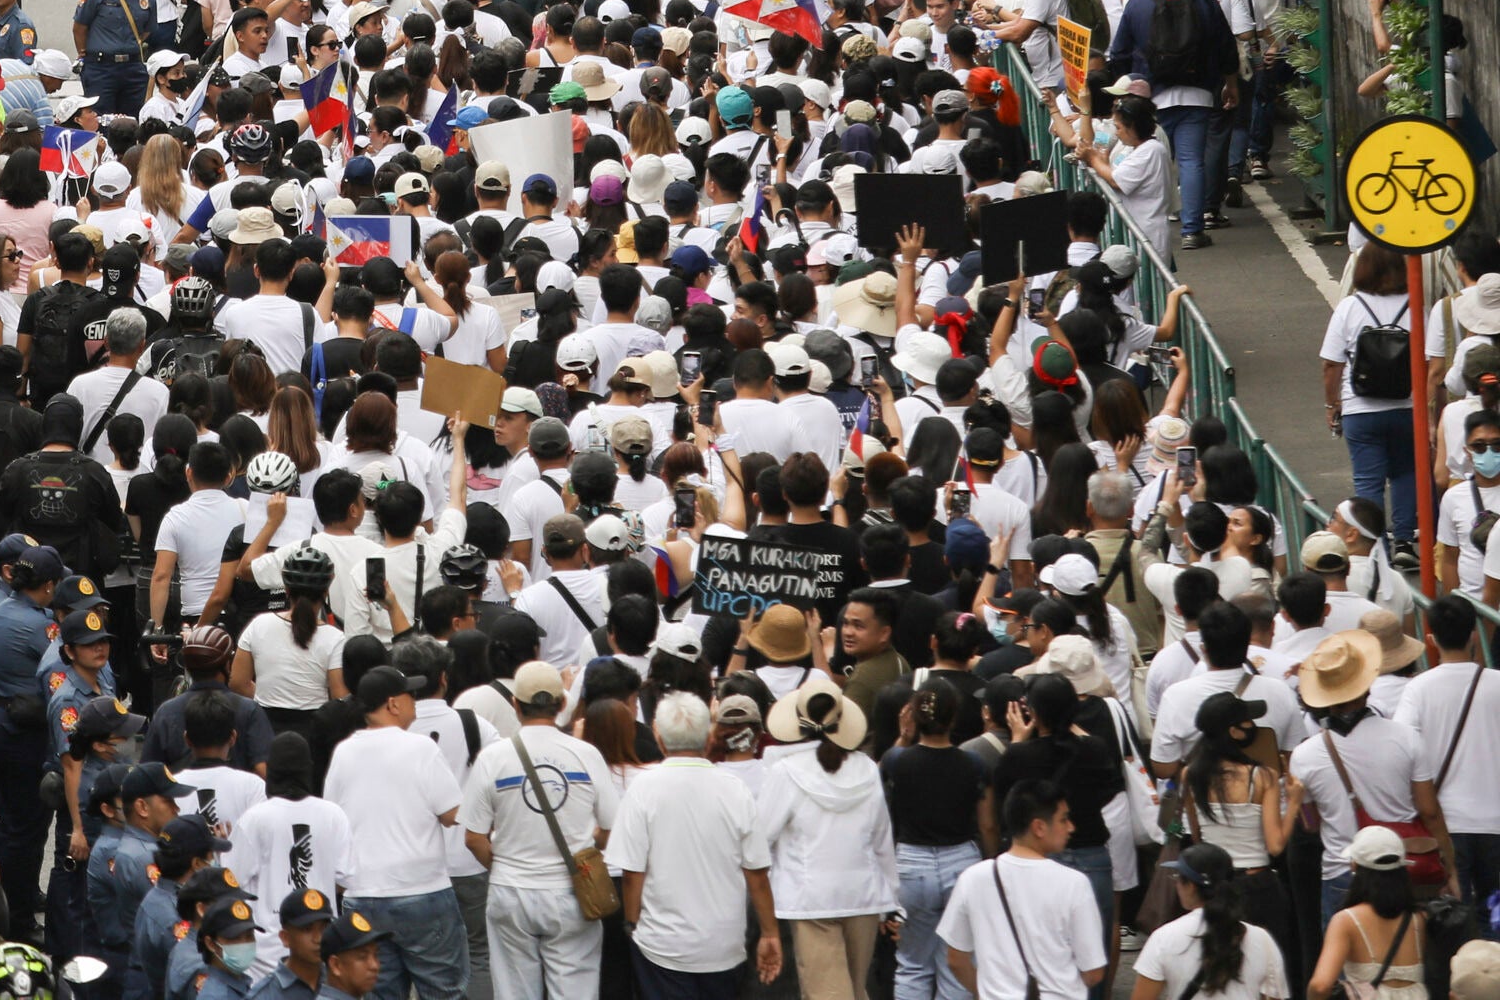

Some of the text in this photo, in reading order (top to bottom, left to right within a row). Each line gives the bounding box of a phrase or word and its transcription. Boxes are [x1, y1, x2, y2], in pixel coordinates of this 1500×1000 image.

[88, 323, 107, 340] EN
[702, 540, 741, 563] MGA
[750, 545, 822, 571] KURAKOT
[707, 567, 817, 599] PANAGUTIN
